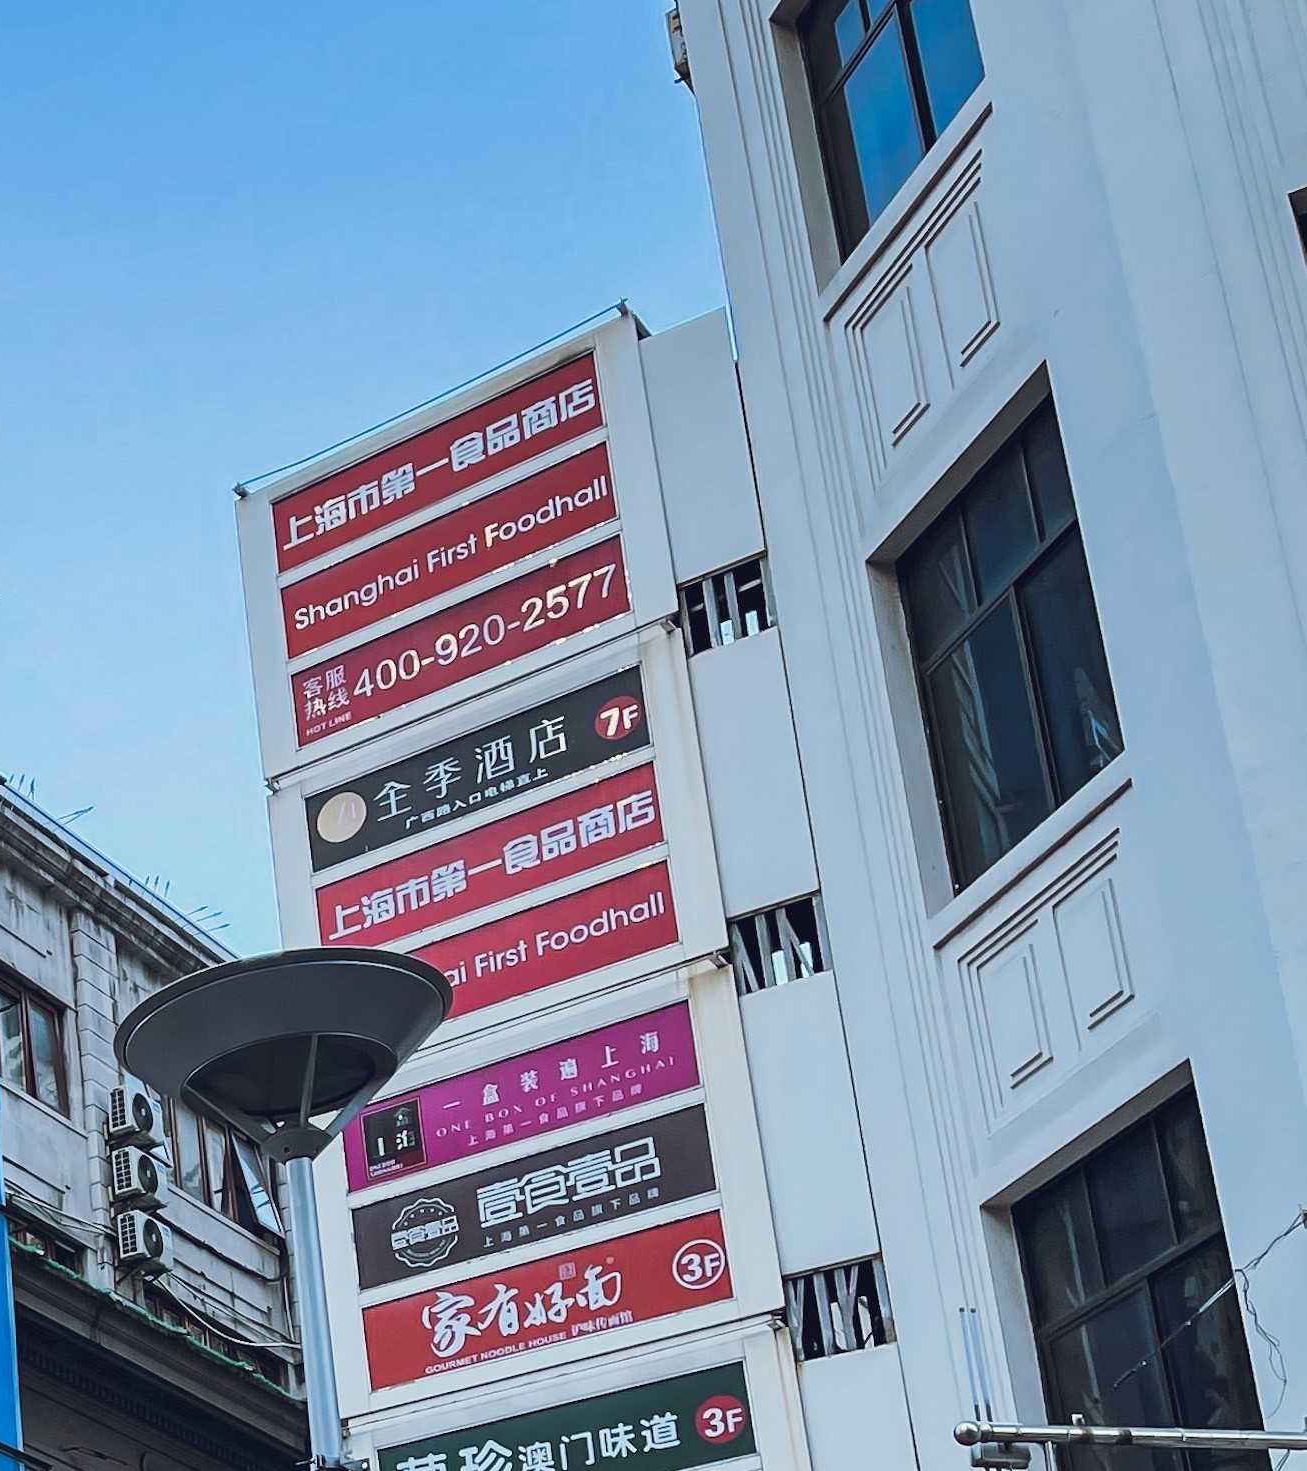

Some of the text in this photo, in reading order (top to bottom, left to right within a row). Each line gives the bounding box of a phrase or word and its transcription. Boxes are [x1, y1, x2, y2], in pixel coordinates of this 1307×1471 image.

[282, 378, 596, 551] 上海市第一食品商店
[294, 475, 607, 630] Shanghai First Foodhall
[353, 564, 617, 698] 400-920-2577
[302, 664, 348, 695] 客服
[303, 689, 350, 721] 热线
[600, 703, 639, 737] 7F
[373, 715, 569, 822] 全季酒店
[404, 766, 548, 829] 广西路入口电梯直上
[328, 789, 655, 941] 上海市第一食品商店
[474, 890, 666, 983] First Foodhall
[680, 1252, 722, 1283] 3F
[421, 1263, 622, 1358] 家有好面
[425, 1332, 567, 1374] GOURMET NOODLE HOUSE
[702, 1406, 743, 1440] 3F
